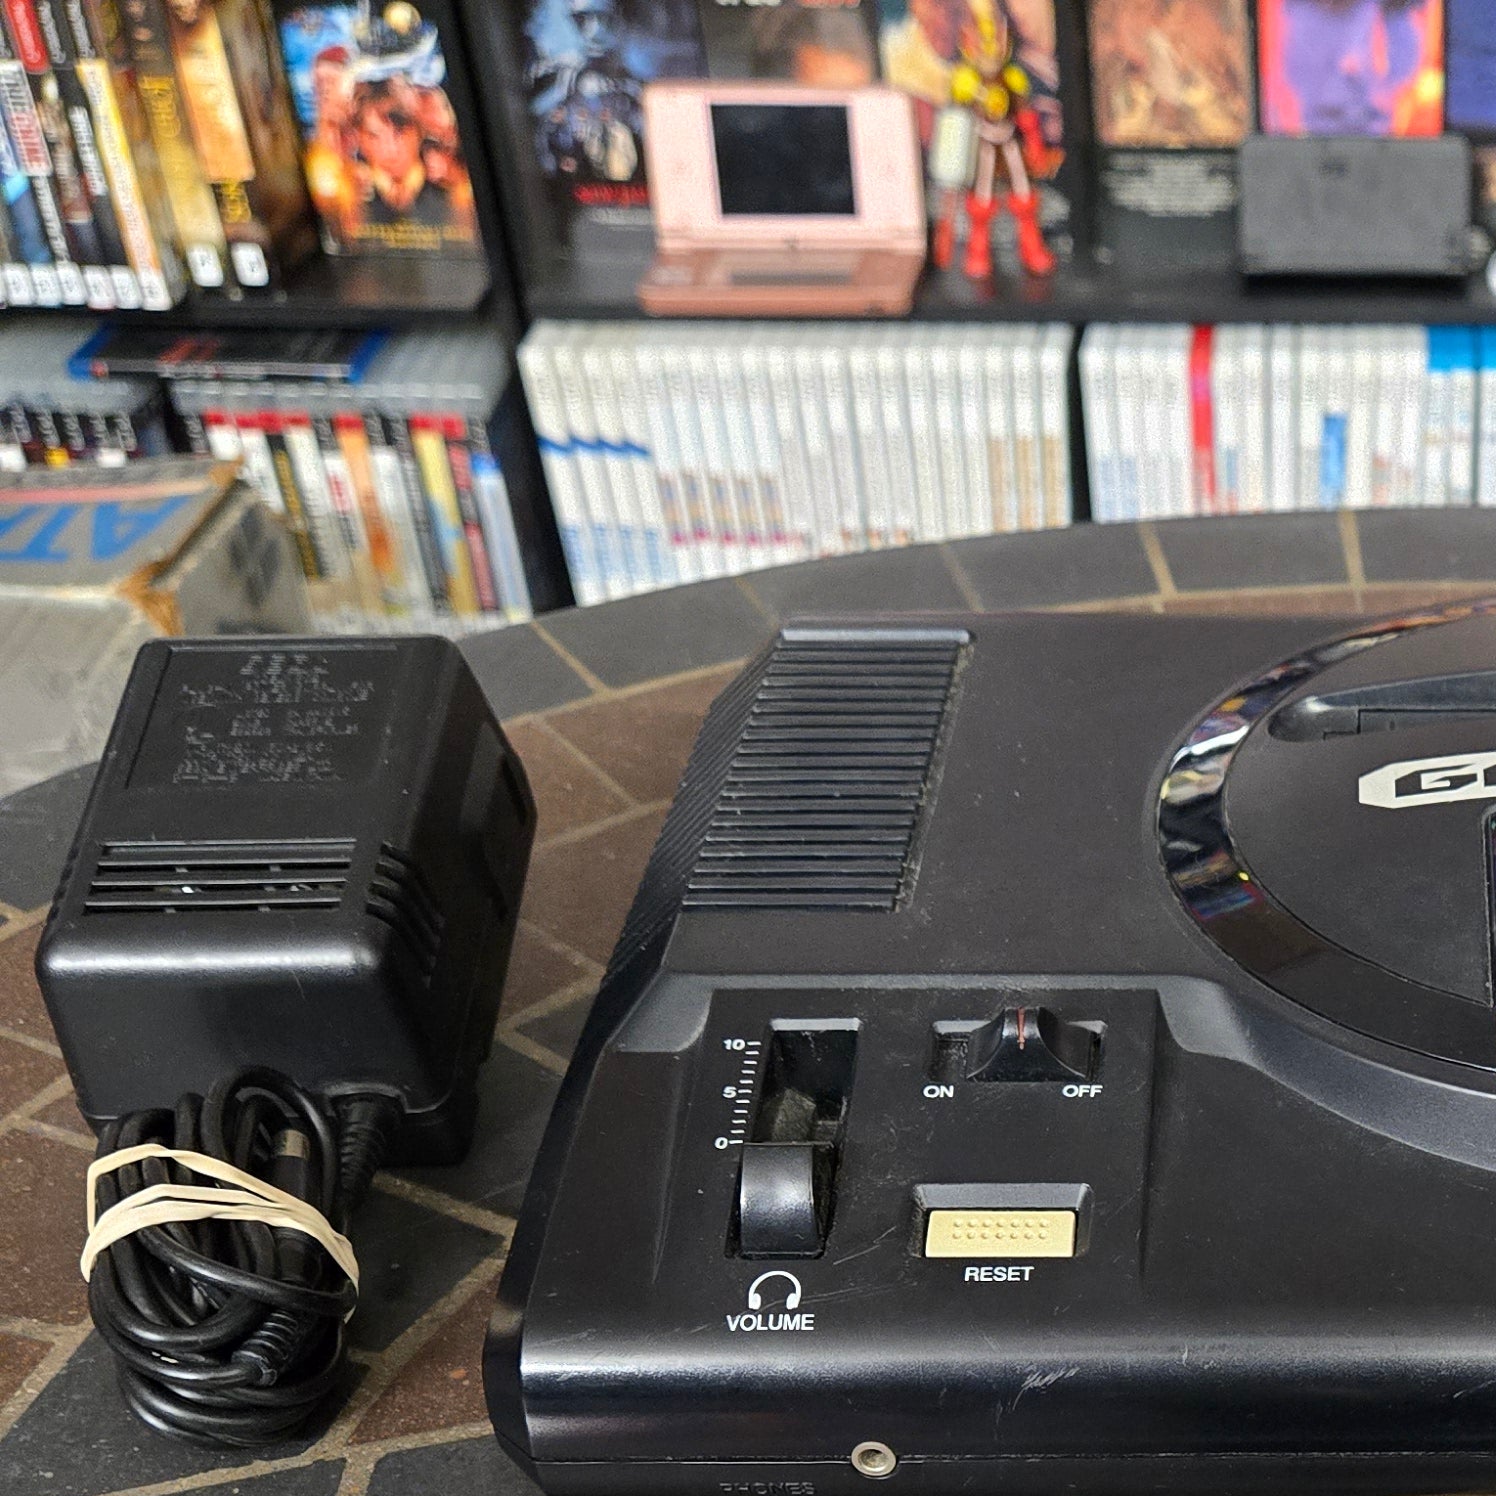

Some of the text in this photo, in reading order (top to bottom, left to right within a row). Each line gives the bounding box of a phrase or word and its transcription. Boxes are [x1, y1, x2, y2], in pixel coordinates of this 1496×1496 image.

[723, 1038, 746, 1051] 10
[722, 1087, 738, 1099] 5
[922, 1085, 955, 1098] ON
[1062, 1084, 1103, 1098] OFF
[714, 1137, 729, 1149] 0
[963, 1266, 1035, 1282] RESET
[726, 1313, 815, 1332] VOLUME
[719, 1482, 815, 1496] PHONES
